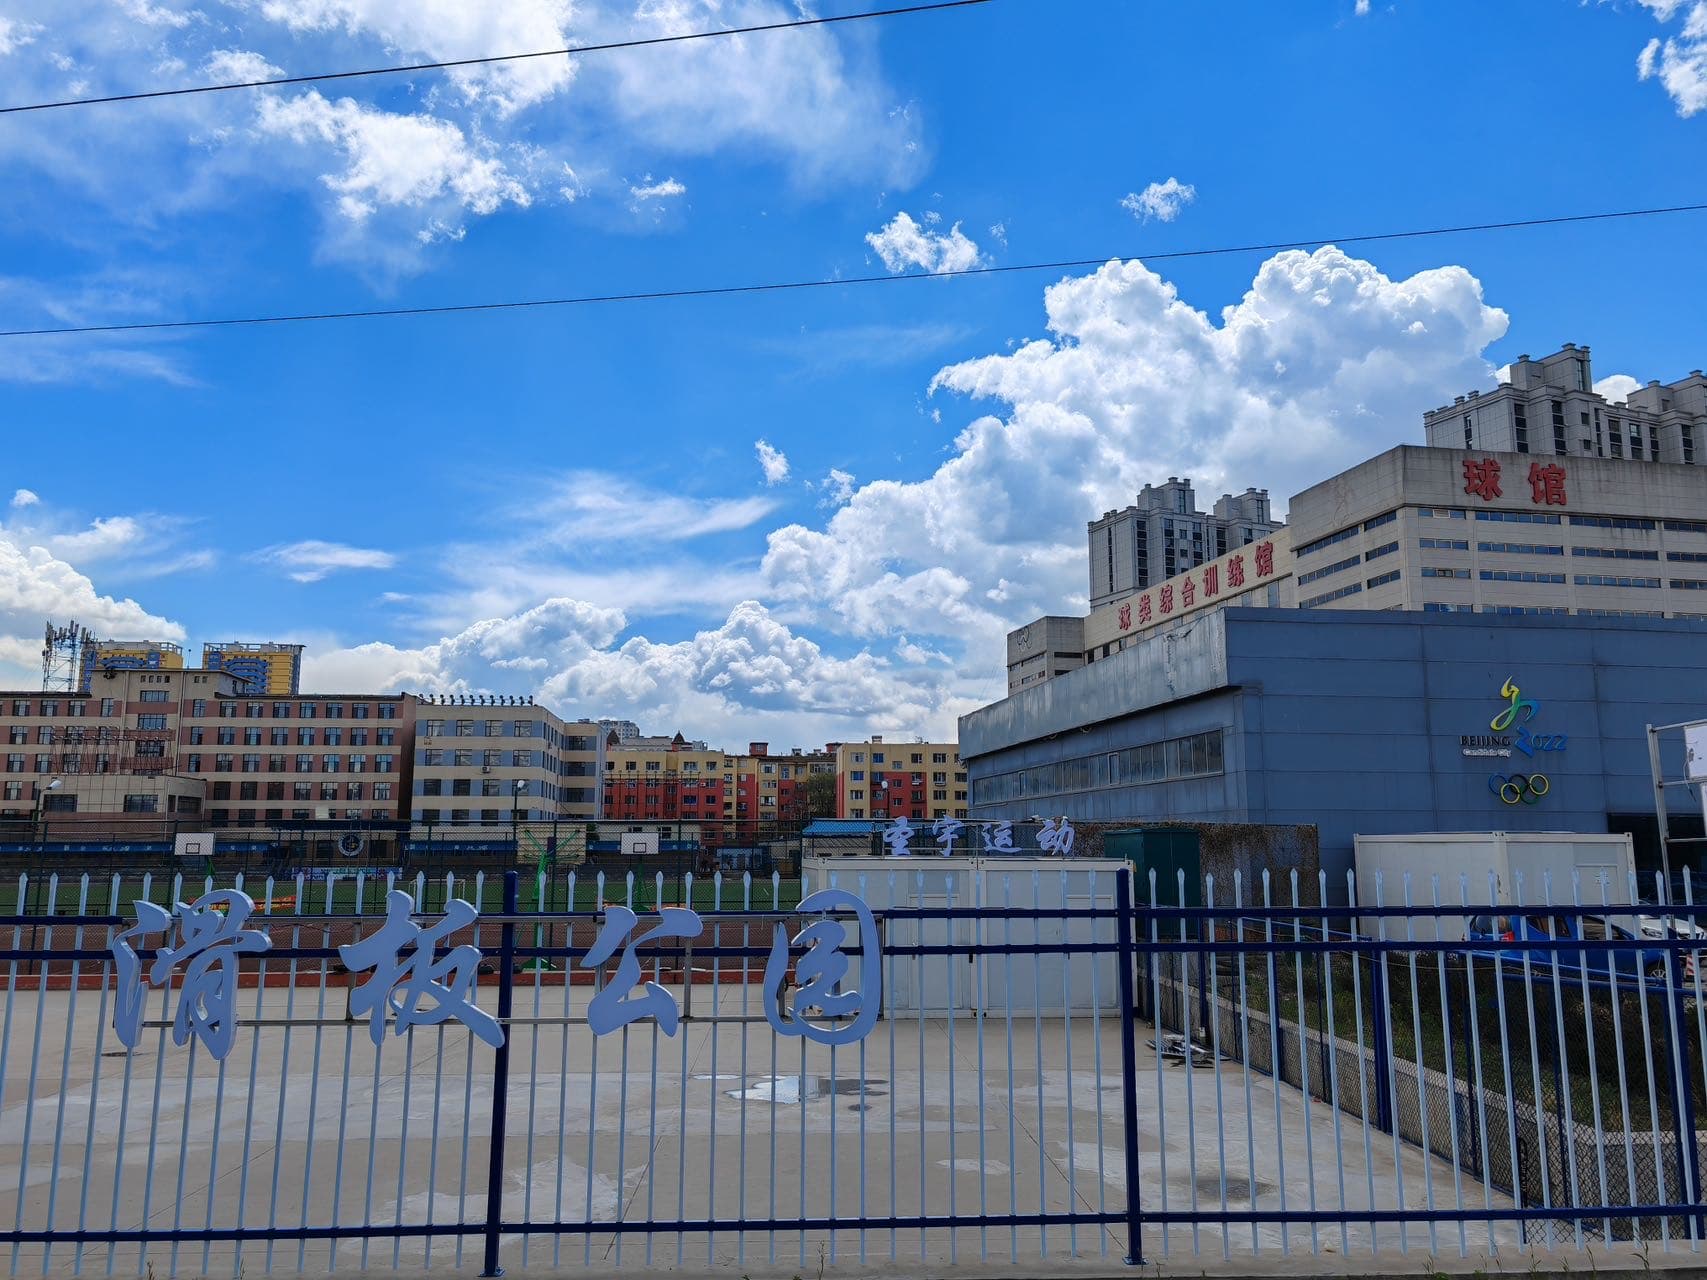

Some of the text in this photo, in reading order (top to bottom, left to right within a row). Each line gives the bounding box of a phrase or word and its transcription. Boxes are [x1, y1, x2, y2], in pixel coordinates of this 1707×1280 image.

[1463, 458, 1567, 505] 球馆
[1118, 541, 1274, 630] 球类综合训练馆
[1460, 725, 1567, 758] BEIJING 2022
[111, 888, 882, 1060] 滑板公园
